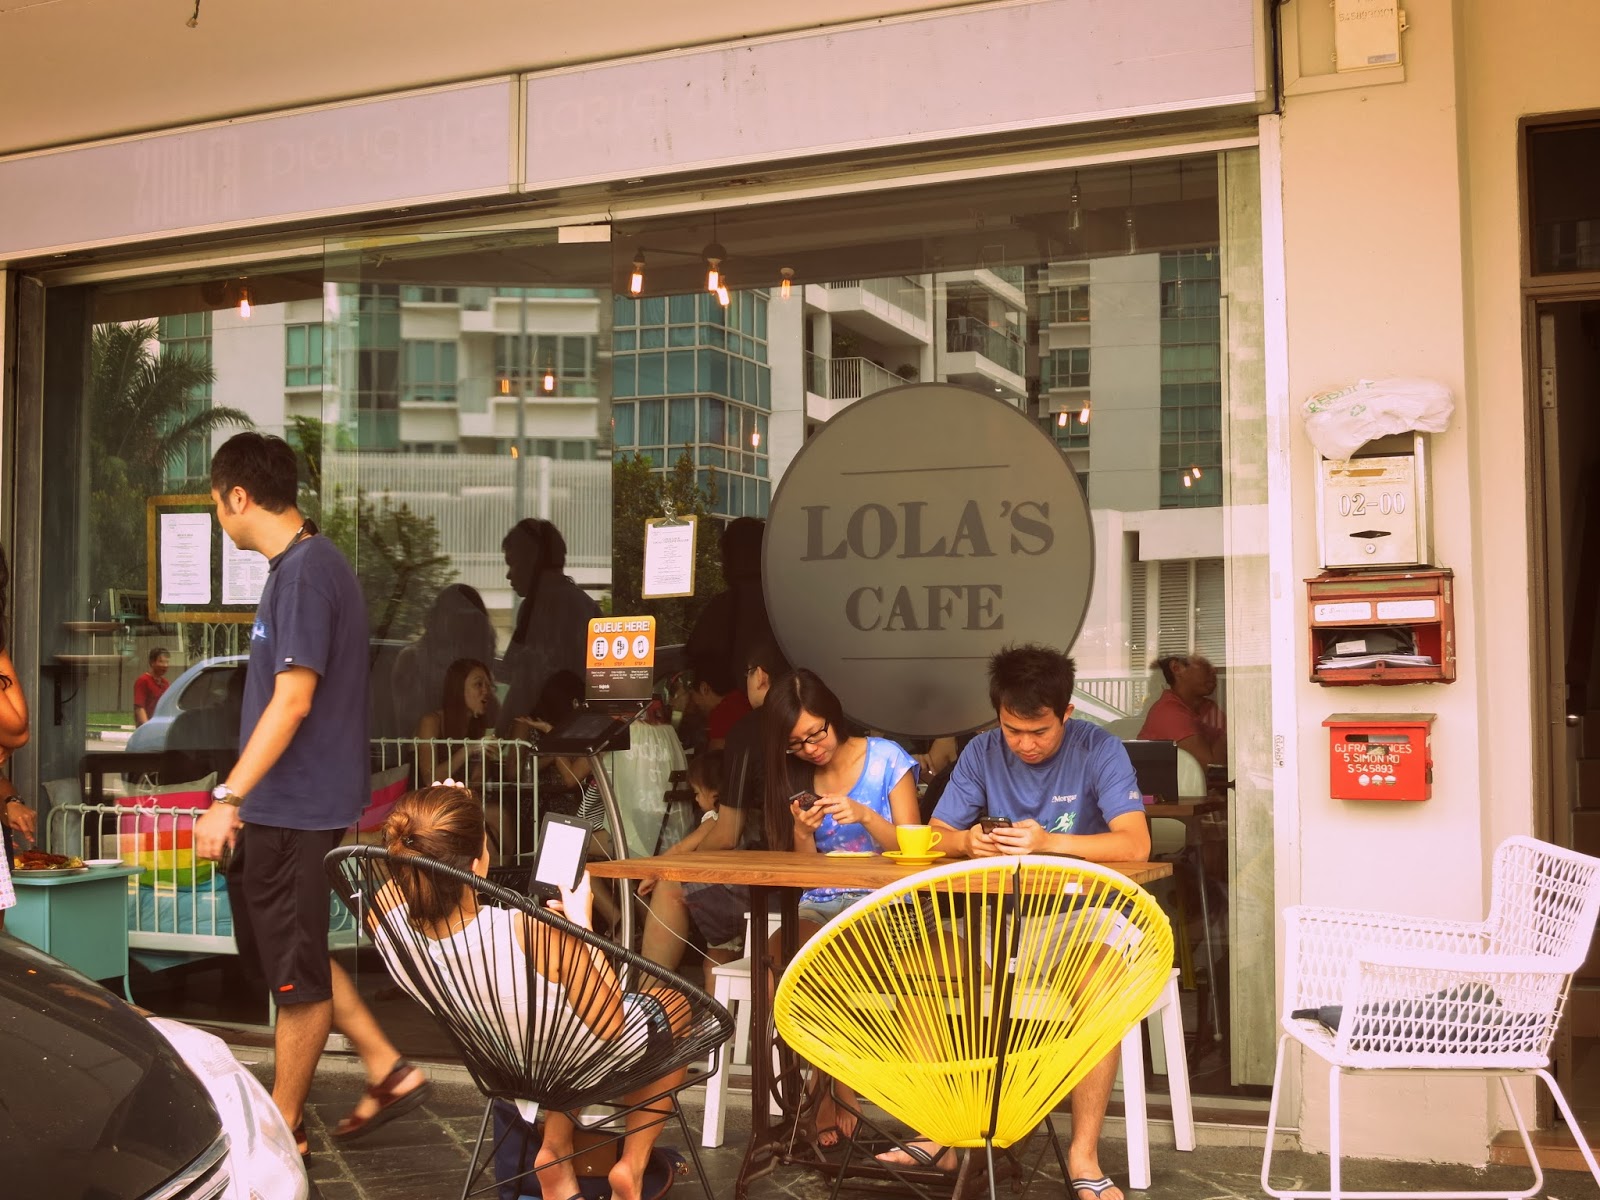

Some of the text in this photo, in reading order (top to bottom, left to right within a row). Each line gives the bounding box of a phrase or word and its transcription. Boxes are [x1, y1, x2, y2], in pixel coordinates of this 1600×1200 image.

[1339, 492, 1405, 517] 02-00
[800, 500, 1054, 561] LOLA'S
[845, 584, 1004, 631] CAFE
[593, 620, 650, 633] QUEUE HERE!
[1334, 743, 1412, 754] GJ FRANCES
[1343, 753, 1400, 764] 5 SIMON RD
[1356, 764, 1394, 774] 545893
